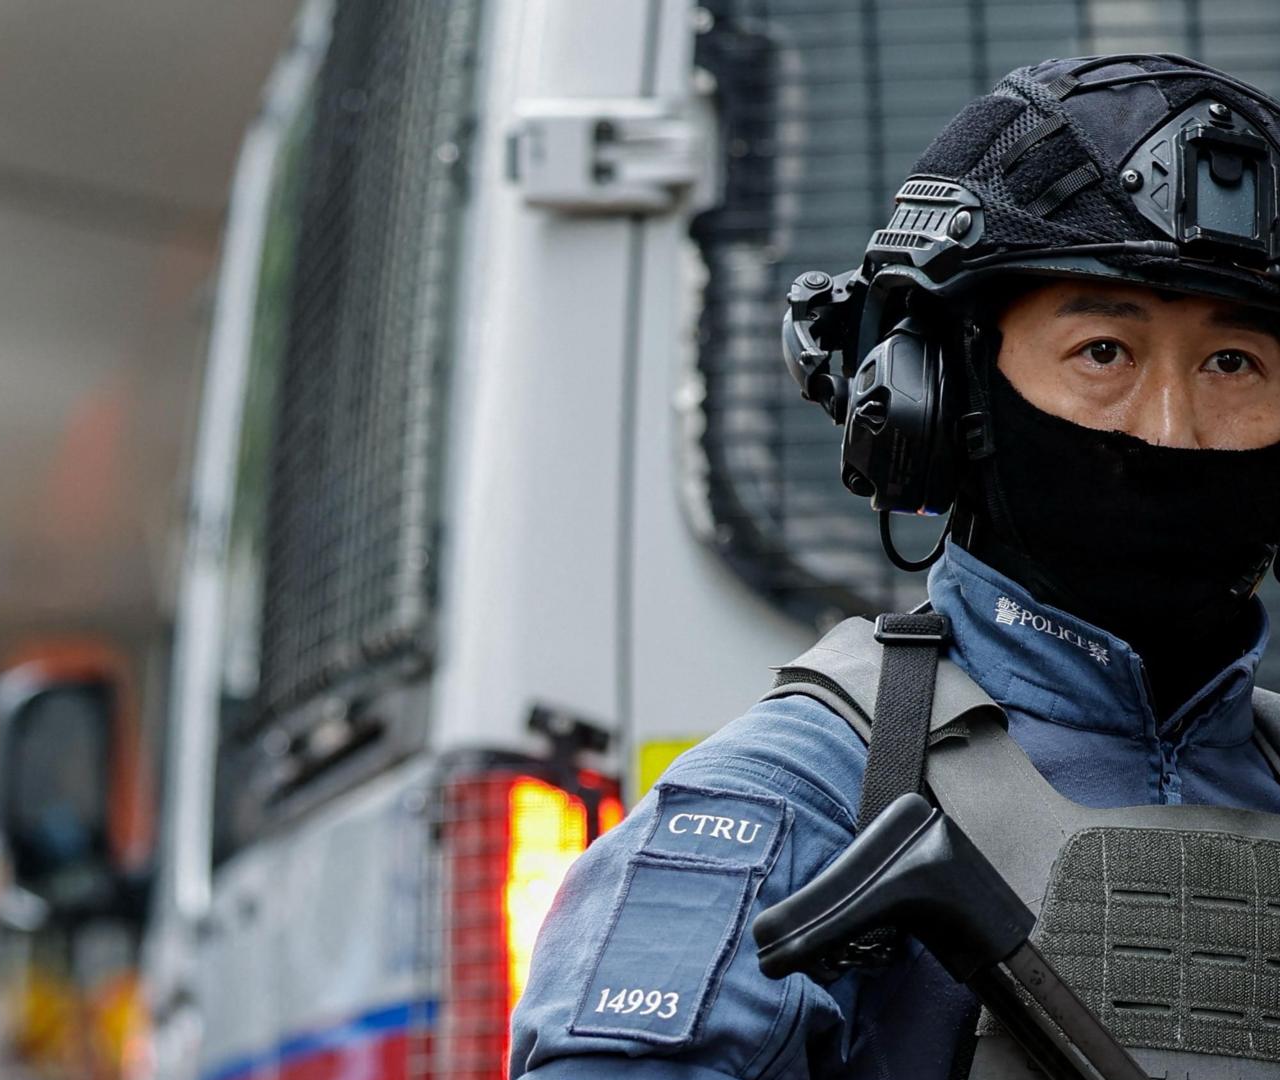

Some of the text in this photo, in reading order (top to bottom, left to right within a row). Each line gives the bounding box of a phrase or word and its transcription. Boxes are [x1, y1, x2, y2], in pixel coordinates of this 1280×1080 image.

[1019, 608, 1089, 650] POLICE
[668, 813, 762, 844] CTRU
[594, 988, 680, 1020] 14993
